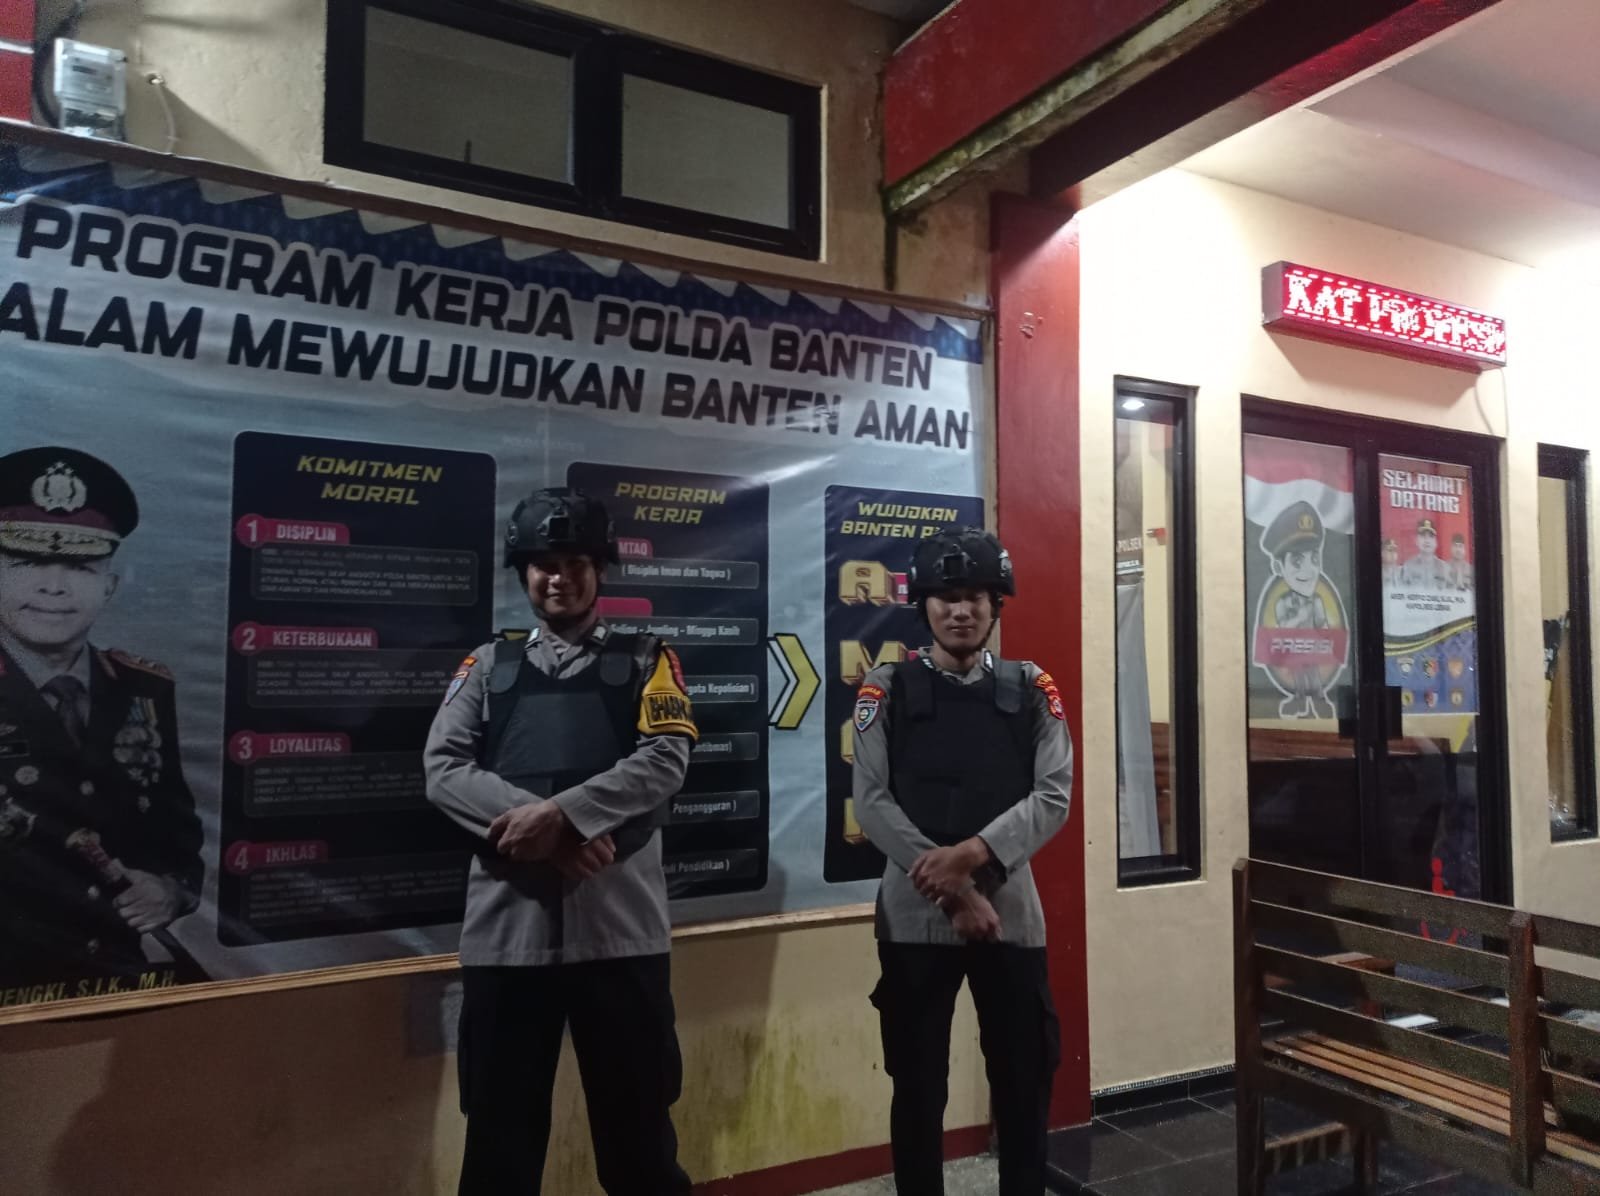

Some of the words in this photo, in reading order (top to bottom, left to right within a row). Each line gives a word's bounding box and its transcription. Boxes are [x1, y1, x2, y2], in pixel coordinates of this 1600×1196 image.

[16, 203, 375, 311] PROGRAM
[395, 267, 574, 342] KERJA
[594, 300, 752, 367] POLDA
[769, 328, 933, 391] BANTEN
[227, 313, 645, 413] MEWUJUDKAN
[661, 372, 842, 436] BANTEN
[854, 399, 970, 450] AMAN
[297, 454, 442, 482] KOMITMEN
[615, 482, 727, 504] PROGRAM
[1383, 468, 1465, 496] SELAMAT
[321, 482, 420, 506] MORAL
[1391, 490, 1460, 514] DATANG
[634, 505, 704, 525] KERJA
[857, 501, 958, 522] WUJUDKAN
[246, 519, 258, 542] 1
[276, 523, 337, 542] DISIPLIN
[840, 520, 916, 539] BANTEN
[617, 541, 648, 557] MTAQ
[241, 627, 257, 650] 2
[272, 631, 374, 648] KETERBUKAAN
[238, 735, 253, 760] 3
[269, 737, 343, 755] LOYALITAS
[672, 801, 732, 816] Pengangguran
[233, 846, 250, 871] 4
[265, 844, 318, 864] IKHLAS
